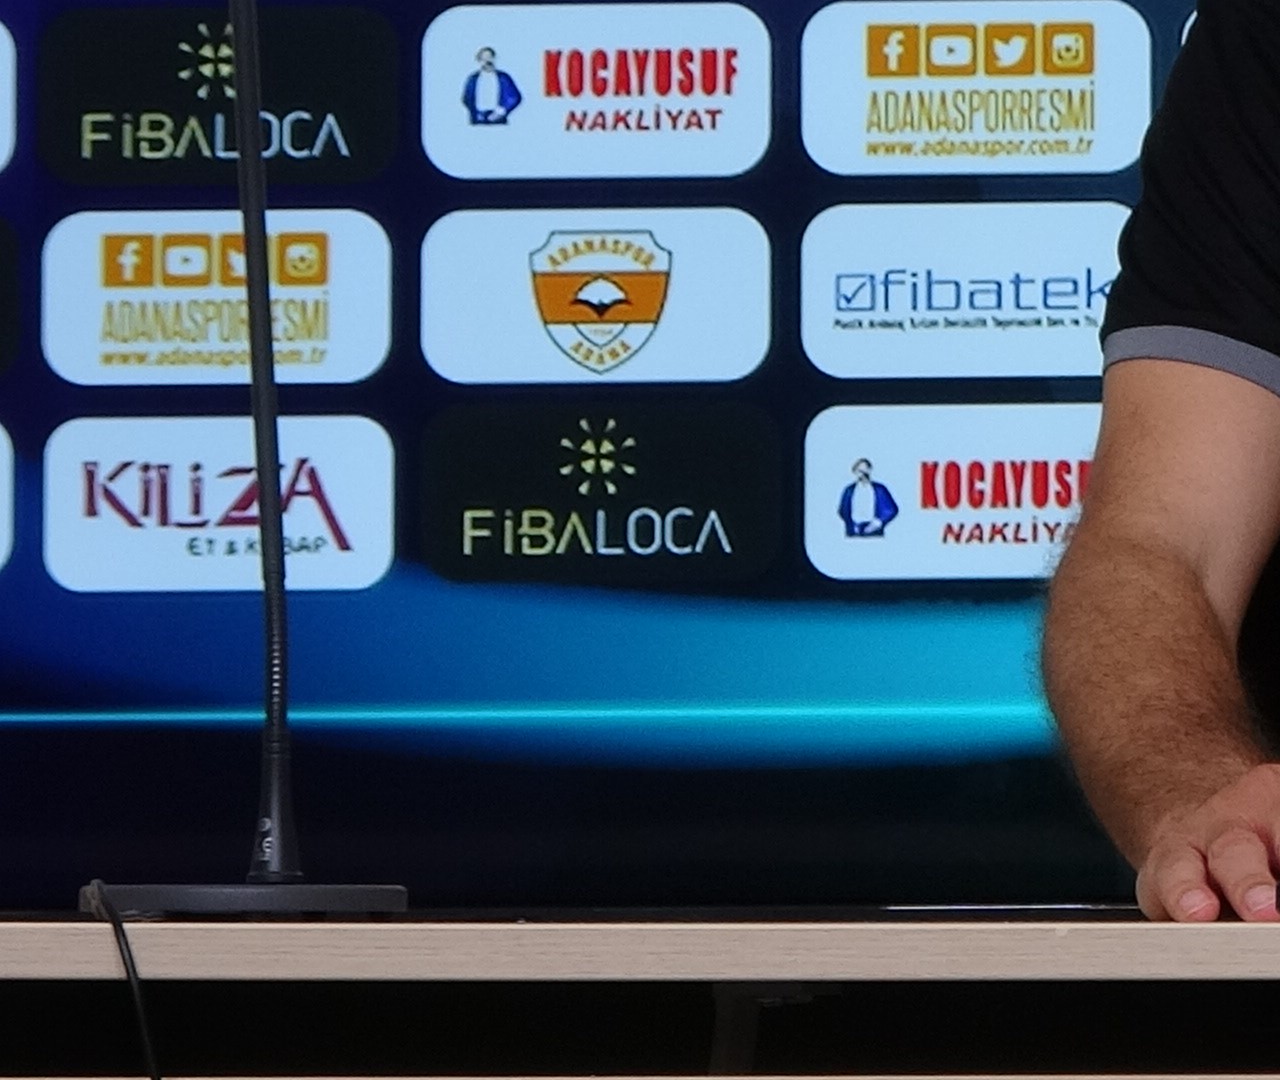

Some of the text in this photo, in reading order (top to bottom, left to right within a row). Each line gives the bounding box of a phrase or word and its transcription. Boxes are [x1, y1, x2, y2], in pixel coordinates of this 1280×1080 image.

[543, 48, 738, 98] KOCAYUSUF
[565, 104, 723, 132] NAKLİYAT
[866, 80, 1095, 135] ADANASPORRESMİ
